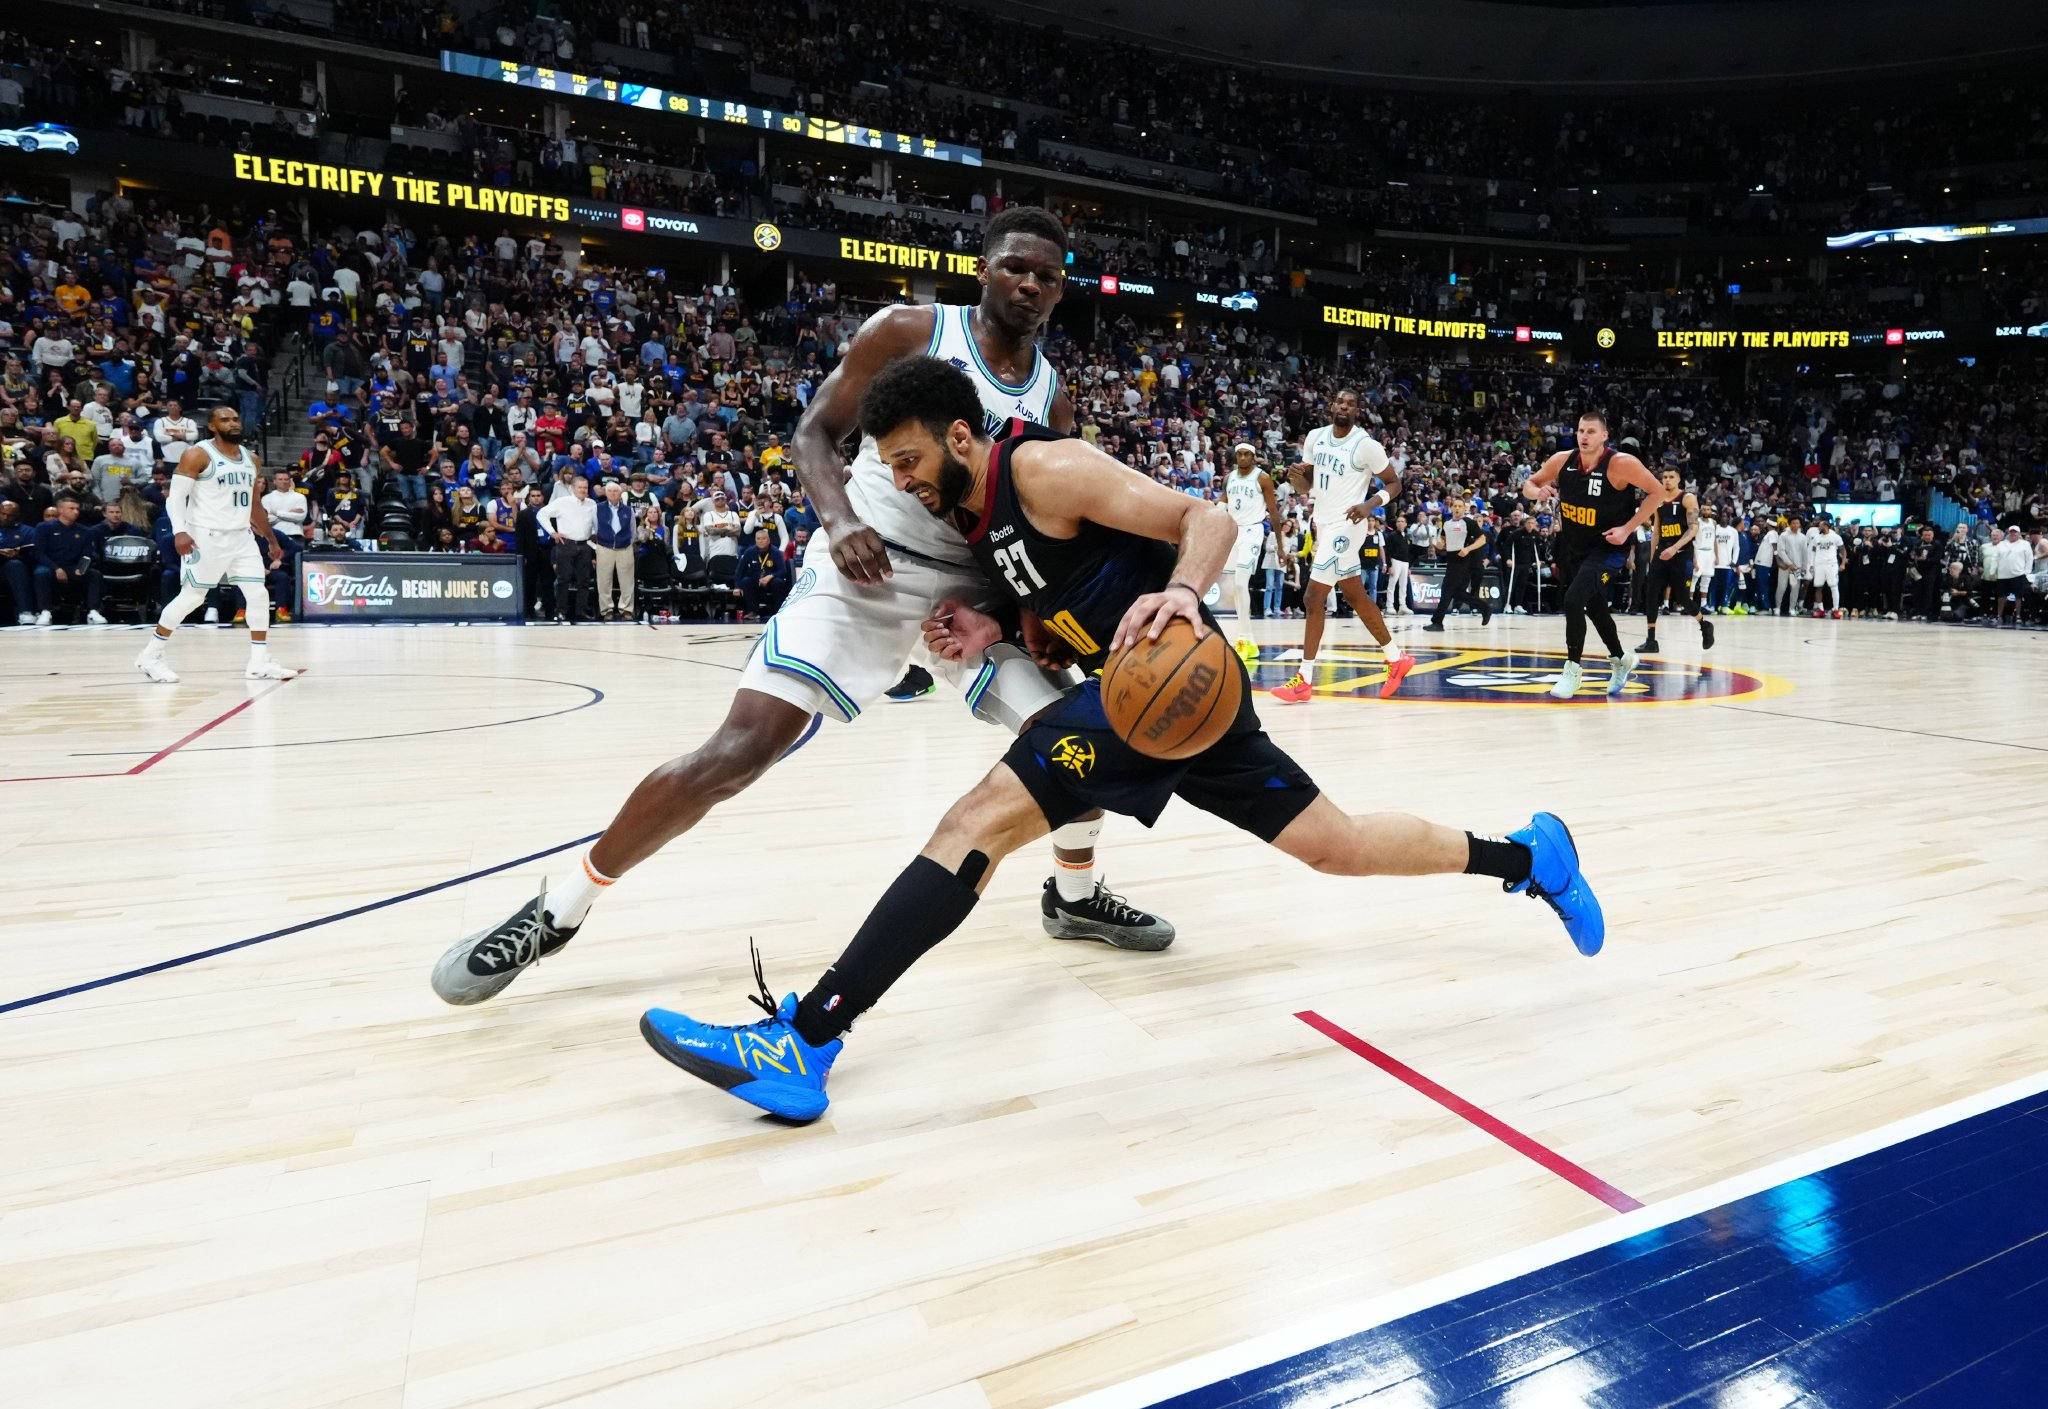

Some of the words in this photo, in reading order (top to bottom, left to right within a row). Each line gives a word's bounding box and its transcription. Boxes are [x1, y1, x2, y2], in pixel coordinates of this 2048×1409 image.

[668, 96, 689, 112] 98
[701, 107, 709, 118] 2
[764, 118, 769, 128] 1
[782, 117, 801, 132] 90
[233, 153, 384, 197] ELECTRIFY
[392, 176, 440, 205] THE
[447, 183, 570, 221] PLAYOFFS
[573, 207, 618, 219] PRESENTED
[647, 216, 699, 233] TOYOTA
[840, 237, 941, 270] ELECTRIFY
[945, 253, 978, 276] THE
[1119, 282, 1155, 295] TOYOTA
[1196, 292, 1218, 304] bZ4X
[1323, 305, 1391, 331] ELECTRIFY
[1394, 316, 1416, 335] THE
[1418, 319, 1486, 340] PLAYOFFS
[1531, 331, 1563, 340] TOYOTA
[1905, 330, 1945, 341] TOYOTA
[1995, 326, 2022, 336] bZ4X
[1657, 331, 1738, 347] ELECTRIFY
[1741, 332, 1769, 347] THE
[1773, 331, 1850, 348] PLAYOFFS
[948, 356, 969, 369] NIKE
[1320, 473, 1329, 490] 11
[1588, 478, 1602, 496] 15
[233, 491, 249, 507] 10
[1235, 499, 1241, 511] 3
[1561, 502, 1596, 527] 5280
[1673, 504, 1677, 516] 1
[989, 524, 1014, 543] ibotta
[1661, 523, 1682, 537] 5280
[112, 545, 150, 557] PLAYOFFS
[993, 539, 1047, 597] 27
[317, 574, 398, 605] Finals
[402, 579, 441, 598] BEGIN
[444, 580, 478, 598] JUNE
[480, 580, 489, 598] 6
[1418, 582, 1441, 602] Fina
